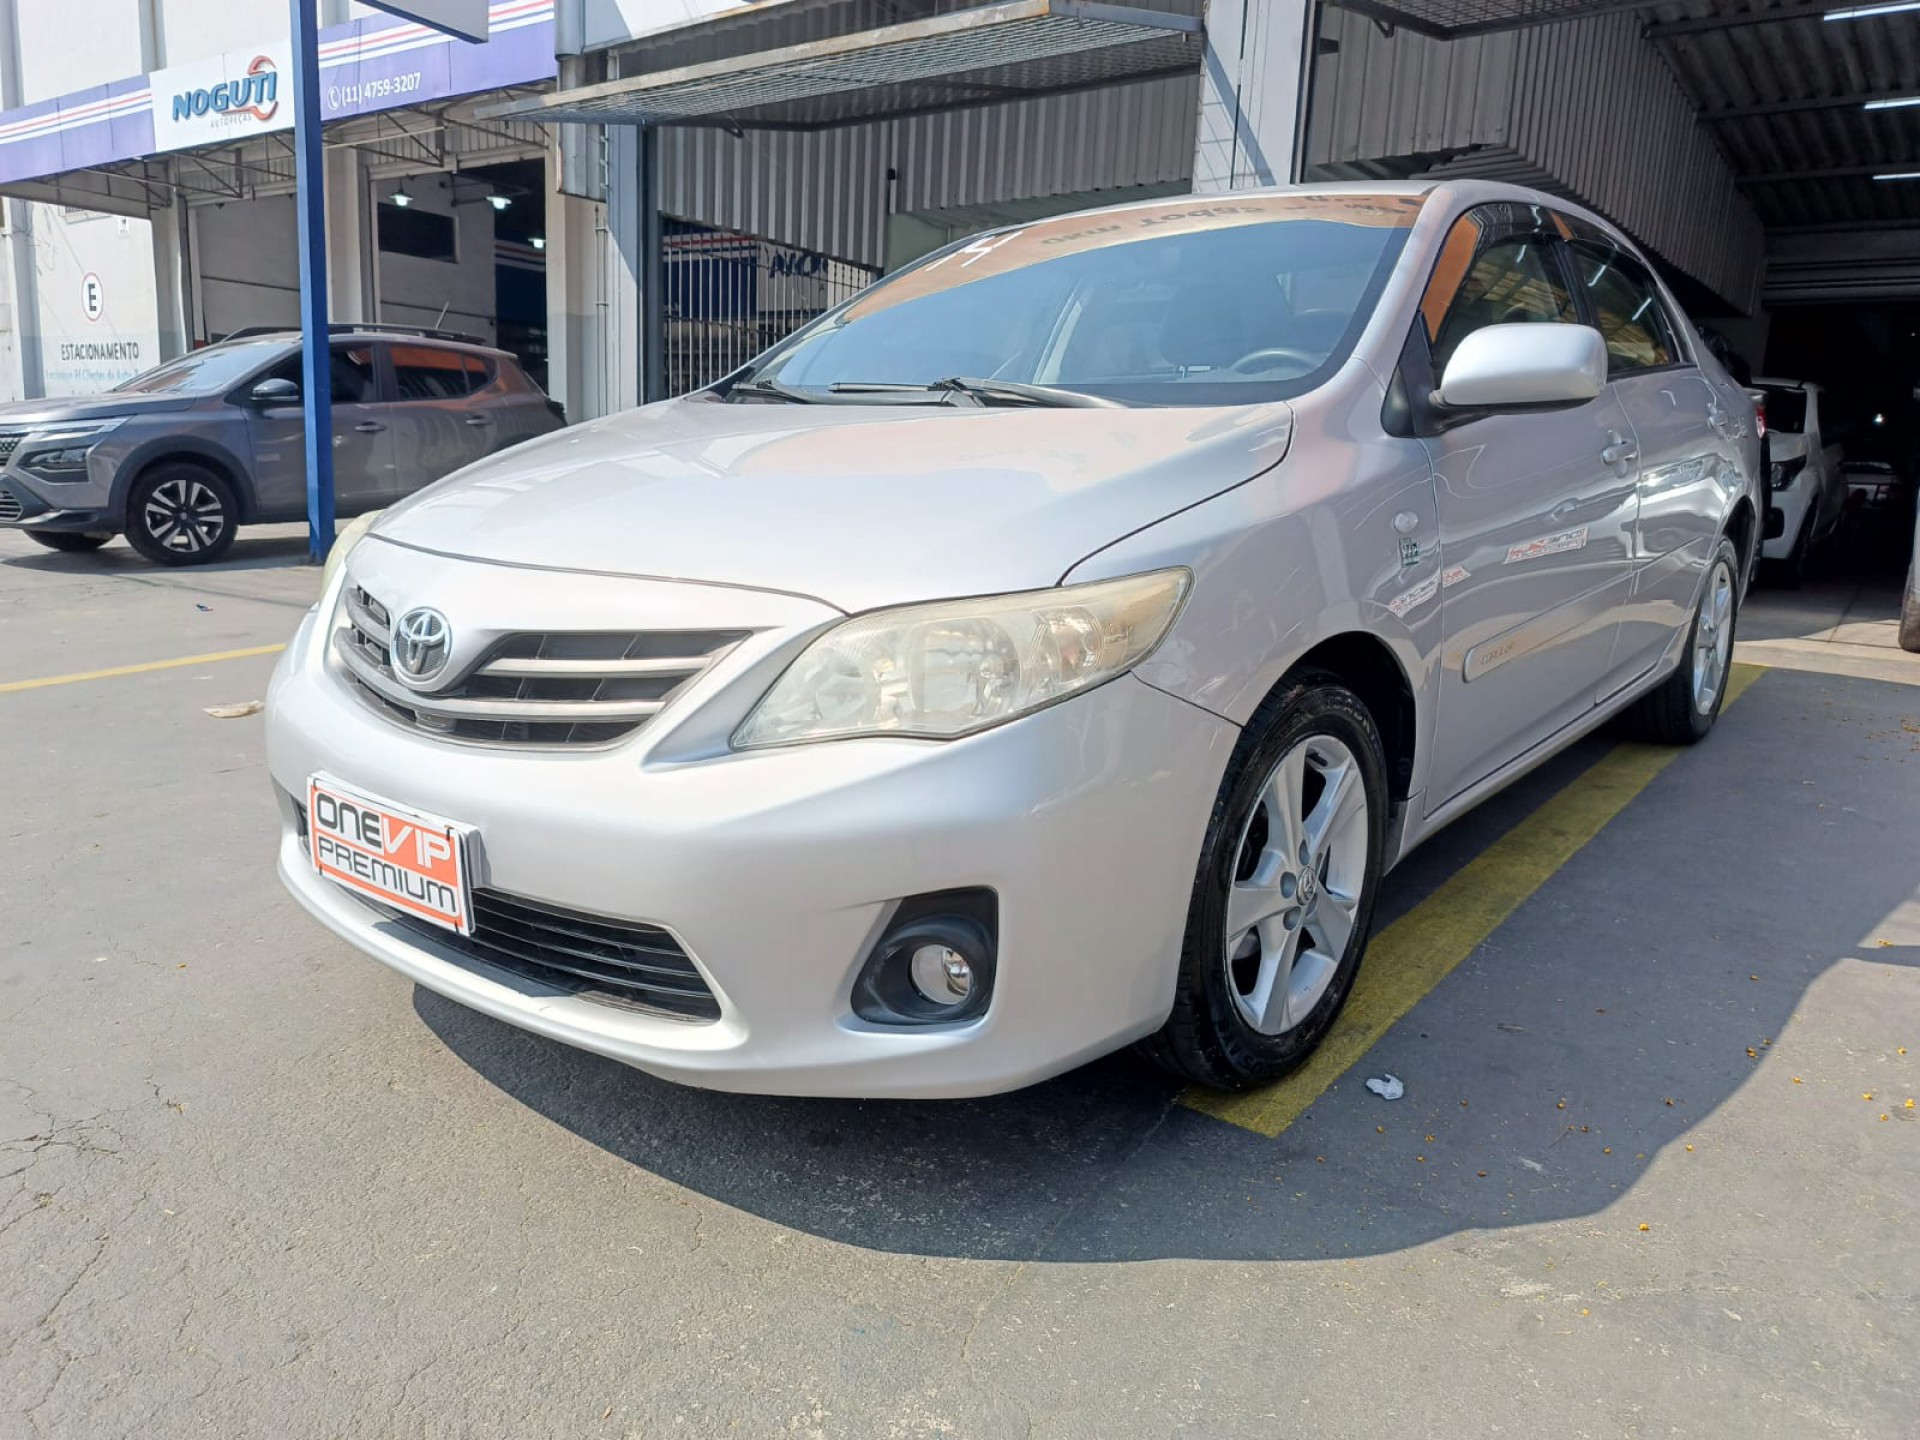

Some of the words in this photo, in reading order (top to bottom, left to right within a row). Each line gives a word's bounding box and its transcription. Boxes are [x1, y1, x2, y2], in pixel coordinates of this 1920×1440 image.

[172, 71, 278, 122] NOGUTI
[342, 84, 362, 107] (11)
[364, 71, 421, 99] 4759-3207
[88, 283, 97, 311] E
[61, 341, 139, 360] ESTACIONAMENTO
[318, 836, 457, 913] PREMIUM
